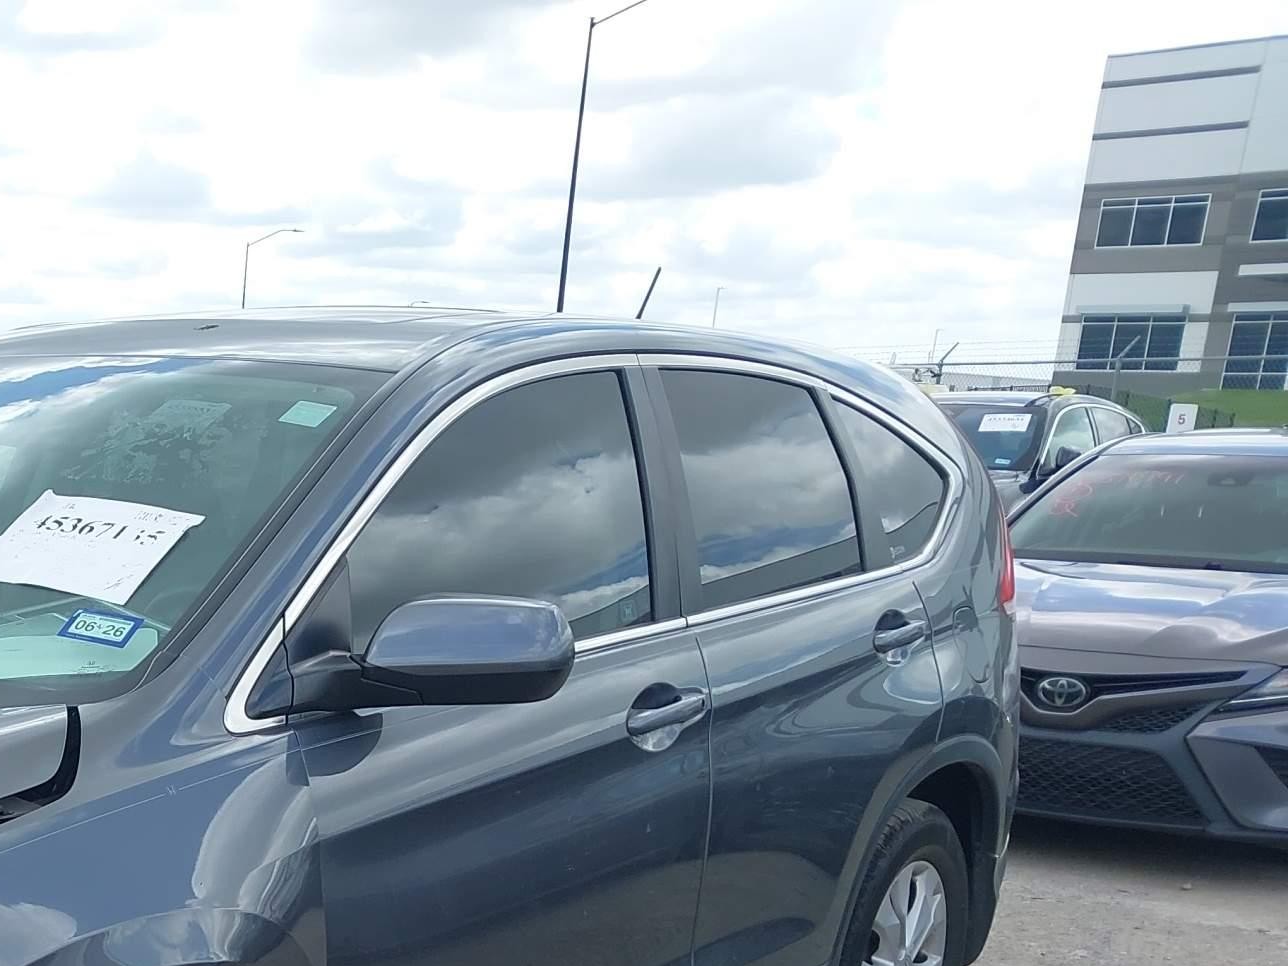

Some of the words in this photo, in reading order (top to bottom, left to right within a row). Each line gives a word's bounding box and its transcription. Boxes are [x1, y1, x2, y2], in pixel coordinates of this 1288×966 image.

[1177, 414, 1186, 425] 5
[74, 619, 98, 632] 06
[102, 624, 126, 638] 26
